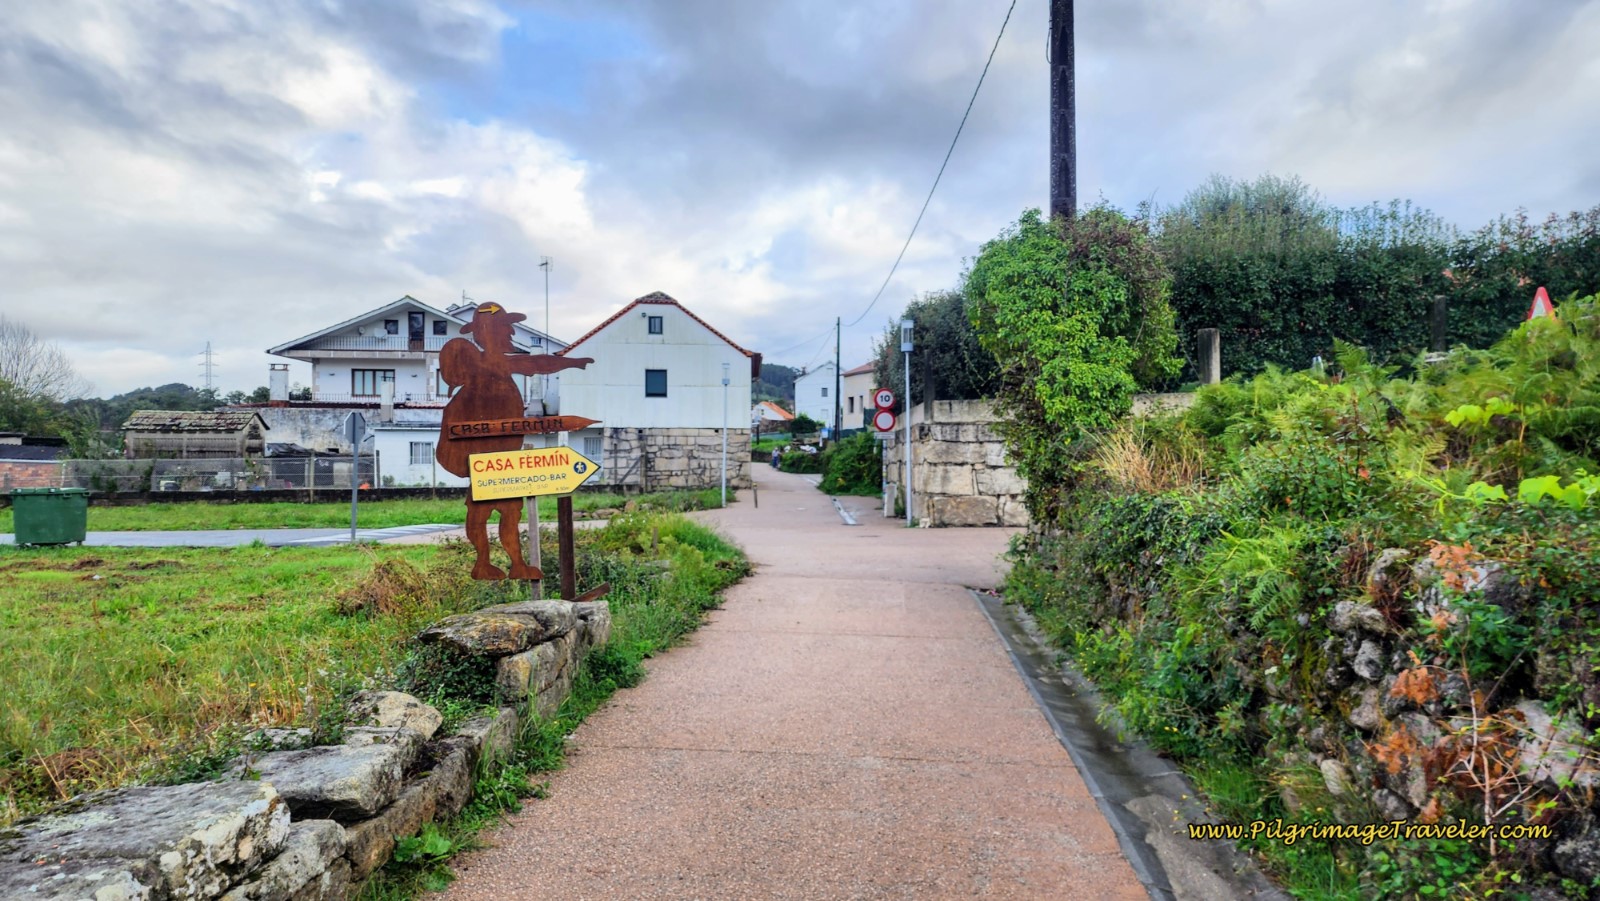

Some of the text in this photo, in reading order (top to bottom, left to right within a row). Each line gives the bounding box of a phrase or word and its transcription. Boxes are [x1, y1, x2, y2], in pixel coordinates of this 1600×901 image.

[880, 394, 891, 403] 10
[473, 450, 570, 473] CASA FERMÍN
[477, 473, 567, 488] SUPERMERCADO-BAR
